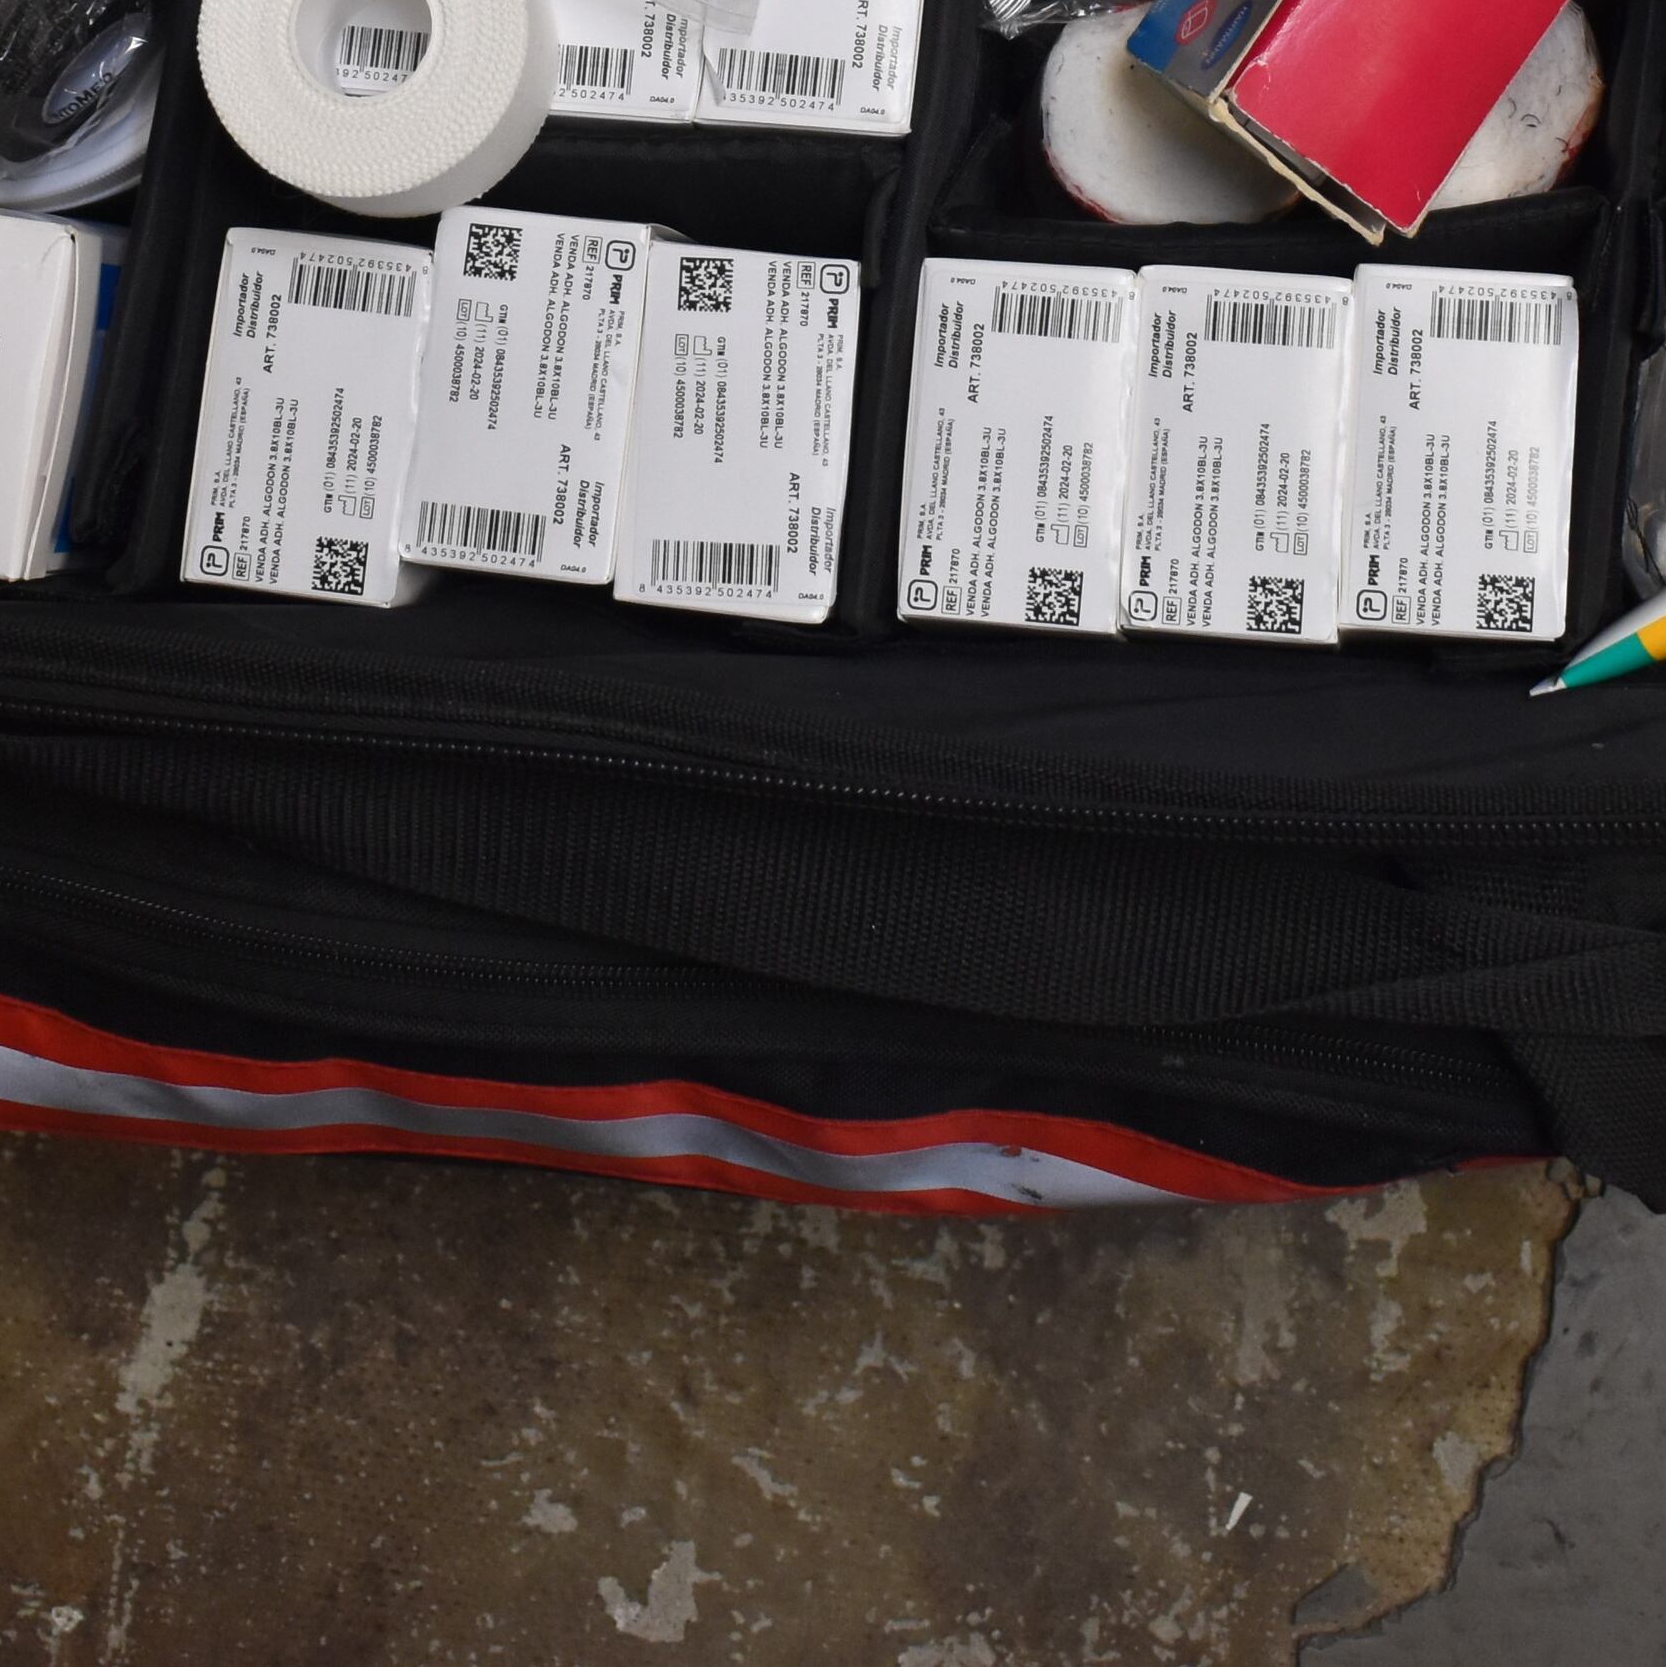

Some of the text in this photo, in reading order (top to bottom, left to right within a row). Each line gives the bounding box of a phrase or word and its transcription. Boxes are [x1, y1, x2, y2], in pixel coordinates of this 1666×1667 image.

[640, 13, 655, 59] 738002
[661, 13, 676, 80] Distribuidor
[851, 24, 867, 69] 738002
[872, 24, 889, 92] Distribuidor
[886, 25, 903, 90] Importador
[364, 70, 410, 84] 50247
[566, 234, 579, 271] VENDA
[781, 261, 792, 297] VENDA
[231, 272, 248, 338] Importador
[245, 271, 263, 338] Distribuidor
[562, 273, 574, 298] ADH.
[582, 265, 594, 301] 217870
[608, 274, 623, 305] PRIM
[799, 291, 809, 327] 217870
[263, 293, 282, 374] ART. 738002
[555, 300, 571, 354] ALGODON
[779, 300, 790, 325] ADH.
[827, 298, 839, 329] PRIM
[933, 302, 949, 368] Importador
[948, 300, 964, 368] Distribuidor
[1387, 306, 1401, 375] Distribuidor
[777, 328, 788, 382] ALGODON
[967, 322, 985, 404] ART. 738002
[1147, 312, 1161, 378] Importador
[1162, 310, 1176, 378] Distribuidor
[1372, 309, 1386, 375] Importador
[1409, 328, 1423, 410] ART. 738002
[448, 343, 465, 403] 4500038782
[487, 348, 506, 430] 08435392502474
[1182, 331, 1198, 413] ART. 738002
[326, 387, 345, 469] 08435392502474
[673, 378, 685, 439] 4500038782
[714, 381, 726, 463] 08435392502474
[366, 414, 383, 475] 4500038782
[1037, 415, 1053, 498] 08435392502474
[1079, 441, 1094, 502] 4500038782
[1255, 423, 1270, 506] 08435392502474
[1484, 420, 1497, 504] 08435392502474
[263, 463, 278, 516] ALGODON
[552, 443, 572, 526] ART. 738002
[1298, 448, 1311, 510] 4500038782
[1527, 446, 1540, 507] 4500038782
[211, 511, 226, 542] PRIM
[239, 515, 252, 551] 217870
[259, 518, 271, 544] ADH.
[572, 479, 590, 549] Distribuidor
[587, 480, 605, 547] Importador
[786, 472, 800, 554] ART. 738002
[808, 507, 821, 576] Distribuidor
[823, 507, 836, 573] Importador
[972, 493, 986, 548] ALGODON
[1191, 503, 1204, 557] ALGODON
[1420, 501, 1432, 556] ALGODON
[254, 546, 267, 583] VENDA
[919, 544, 933, 576] PRIM
[948, 548, 961, 584] 217870
[969, 550, 981, 576] ADH.
[1138, 555, 1152, 587] PRIM
[1168, 558, 1180, 594] 217870
[1189, 560, 1200, 586] ADH.
[1367, 554, 1380, 586] PRIM
[1397, 557, 1408, 593] 217870
[1418, 559, 1429, 585] ADH.
[965, 578, 978, 616] VENDA
[1186, 588, 1198, 626] VENDA
[1415, 587, 1427, 625] VENDA
